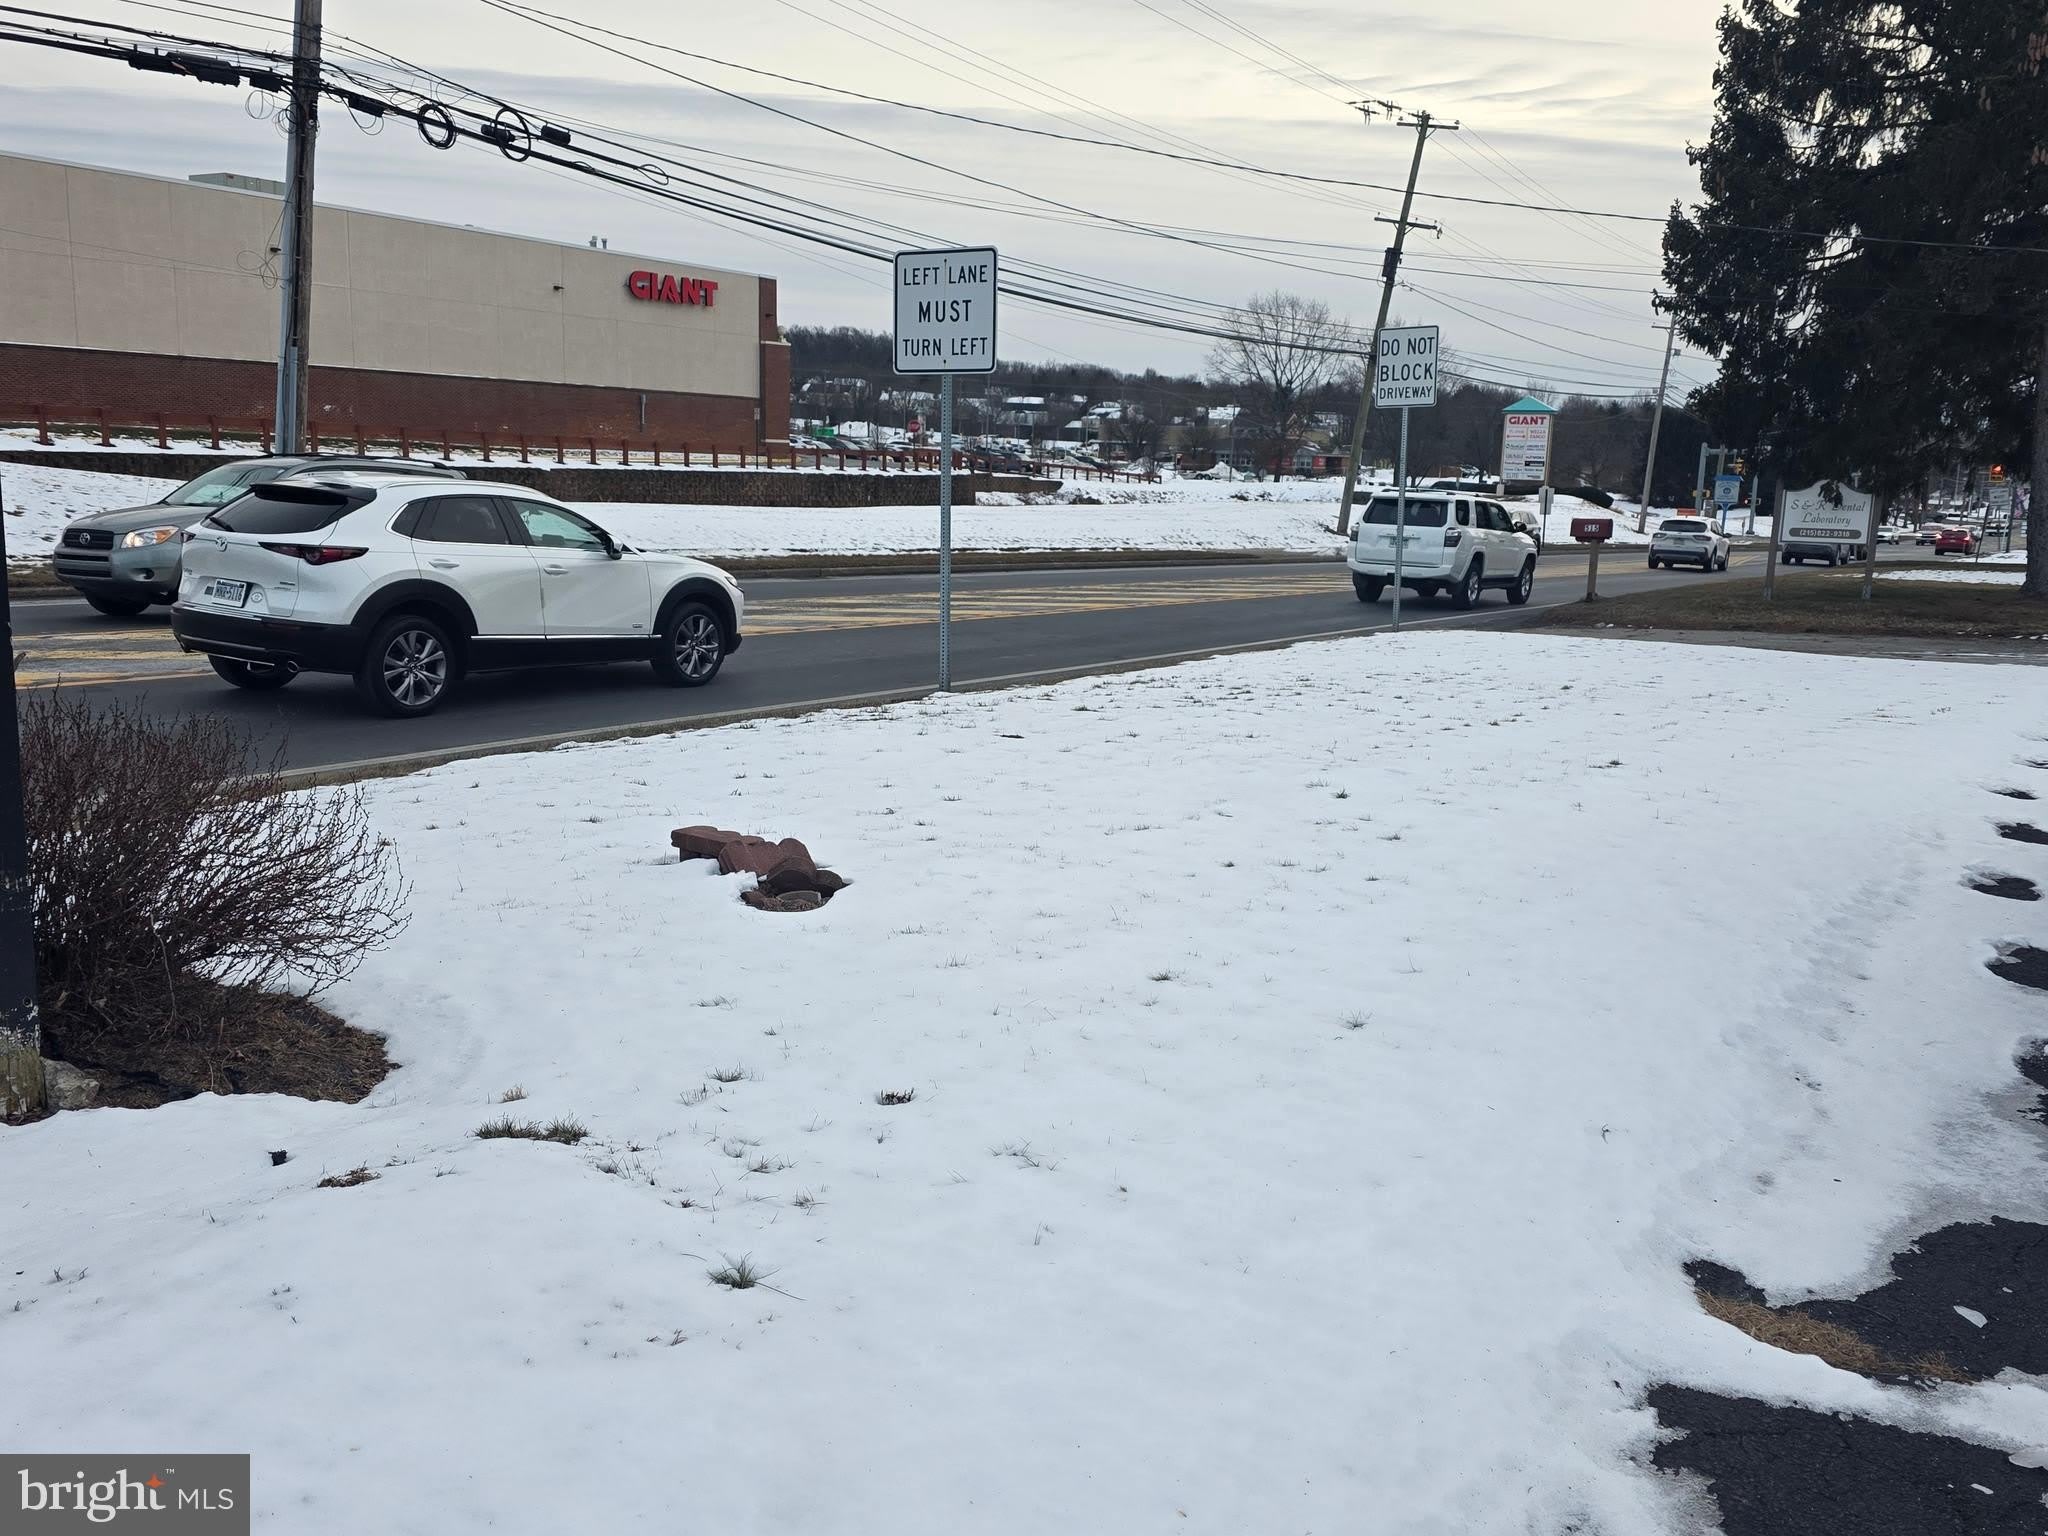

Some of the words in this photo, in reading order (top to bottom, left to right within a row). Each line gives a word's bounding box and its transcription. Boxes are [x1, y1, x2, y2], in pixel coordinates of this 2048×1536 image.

[903, 267, 940, 286] LEFT
[948, 264, 988, 284] LANE
[629, 270, 719, 307] GIANT
[918, 299, 972, 323] MUST
[902, 338, 942, 357] TURN
[951, 337, 988, 356] LEFT
[1381, 338, 1400, 357] DO
[1407, 337, 1435, 355] NOT
[1380, 362, 1433, 381] BLOCK
[1379, 385, 1433, 400] DRIVEWAY
[1508, 415, 1547, 426] GIANT
[1790, 499, 1799, 510] S
[1801, 500, 1814, 510] &
[1801, 512, 1852, 527] Laboratory
